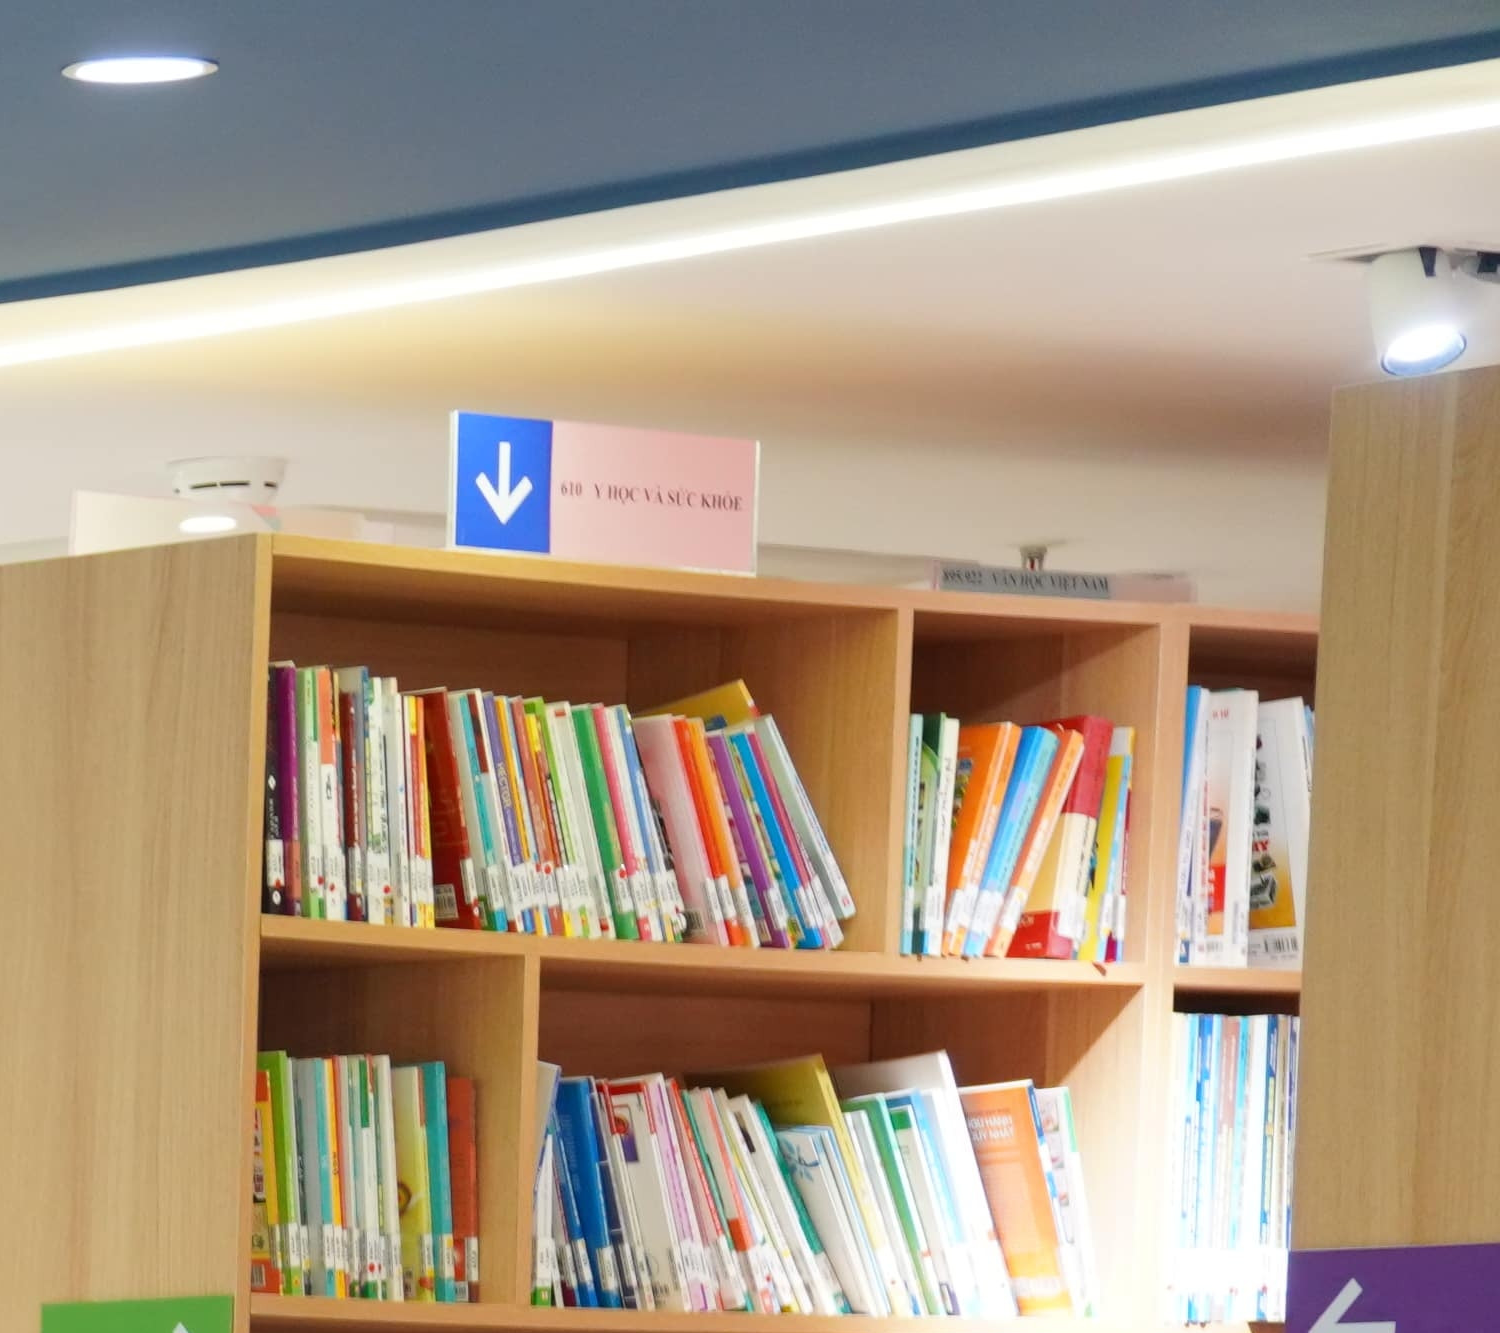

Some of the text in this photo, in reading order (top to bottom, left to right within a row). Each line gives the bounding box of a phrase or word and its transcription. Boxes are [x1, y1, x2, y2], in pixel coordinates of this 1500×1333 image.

[561, 481, 582, 497] 610
[594, 483, 603, 500] Y
[608, 485, 639, 505] HỌC
[1082, 575, 1108, 592] NAM
